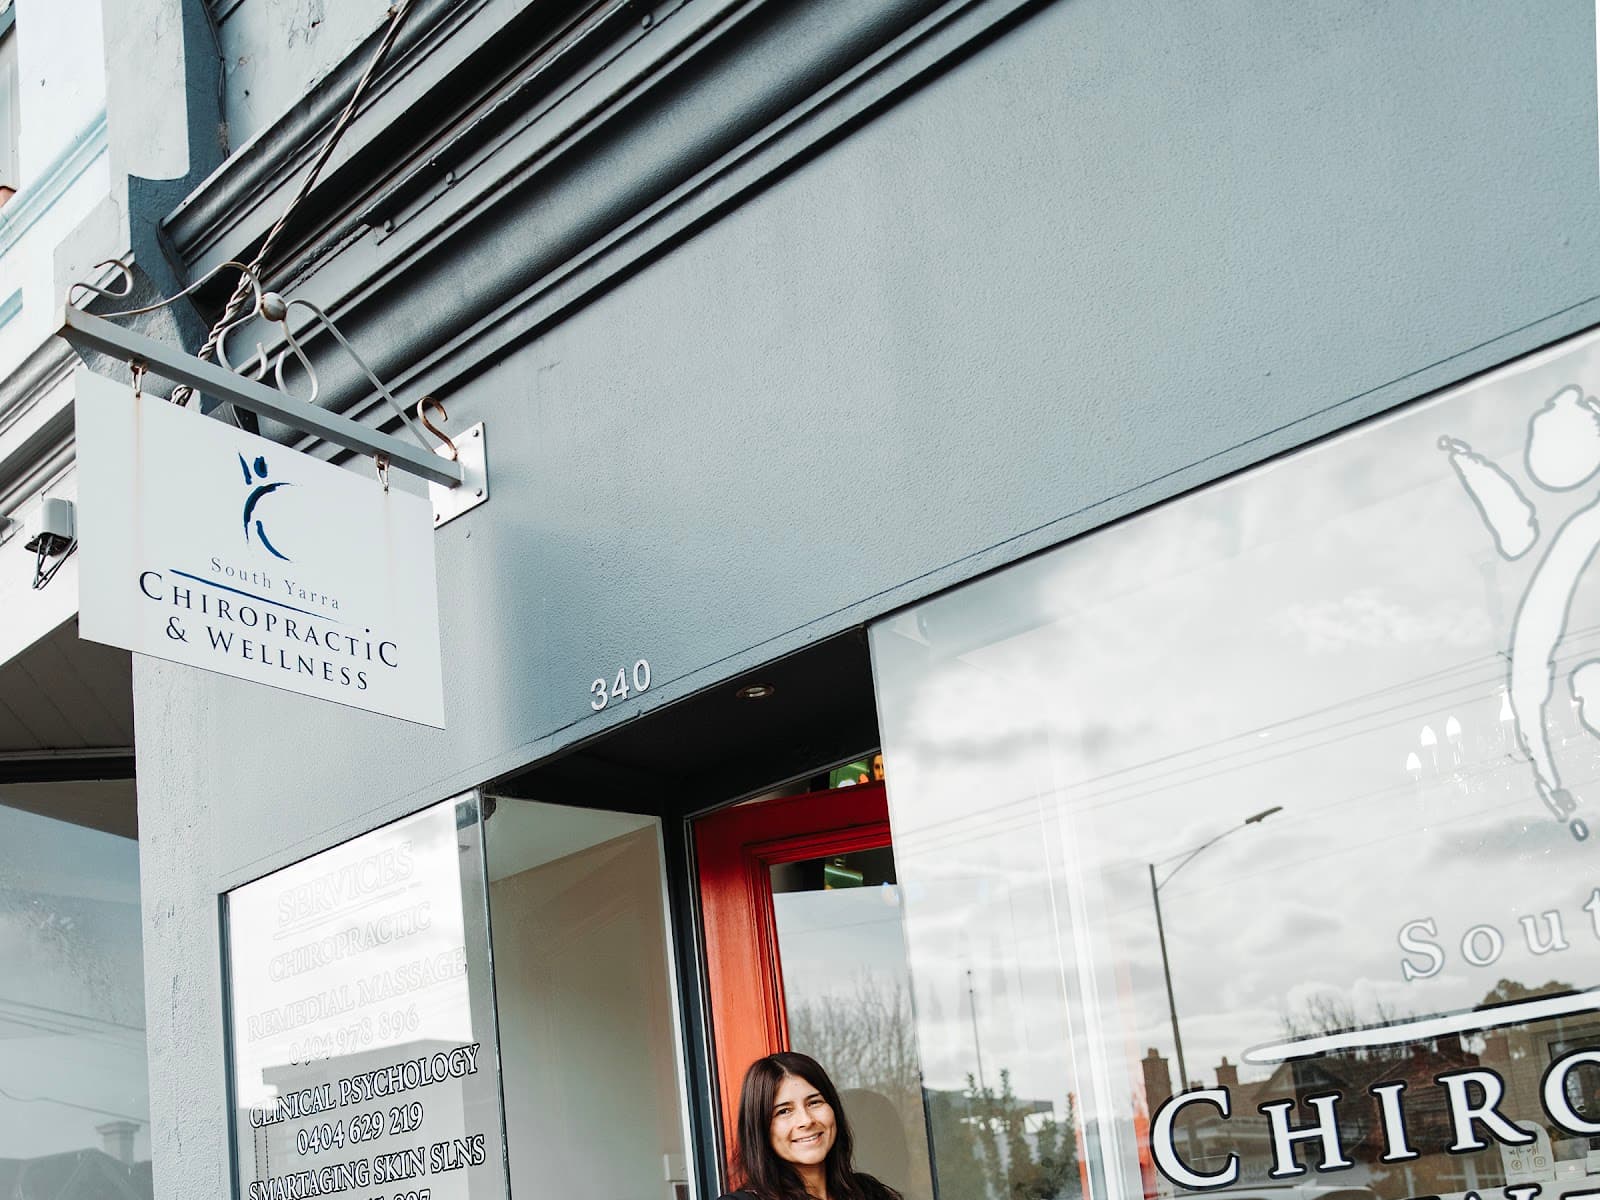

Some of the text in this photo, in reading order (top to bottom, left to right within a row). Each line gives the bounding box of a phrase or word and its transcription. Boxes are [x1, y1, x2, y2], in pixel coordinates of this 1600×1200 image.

[211, 557, 340, 610] South Yarra
[166, 616, 369, 690] & WELLNESS
[591, 659, 651, 711] 340
[278, 841, 414, 927] SERVICES
[268, 902, 432, 982] CHIROPRACTIC
[247, 946, 467, 1042] REMEDIAL MASSAGE
[249, 1043, 480, 1128] CLINICAL PSYCHOLOGY
[296, 1101, 423, 1155] 0404 629 219
[373, 1147, 426, 1184] SKIN
[430, 1134, 486, 1174] SLNS
